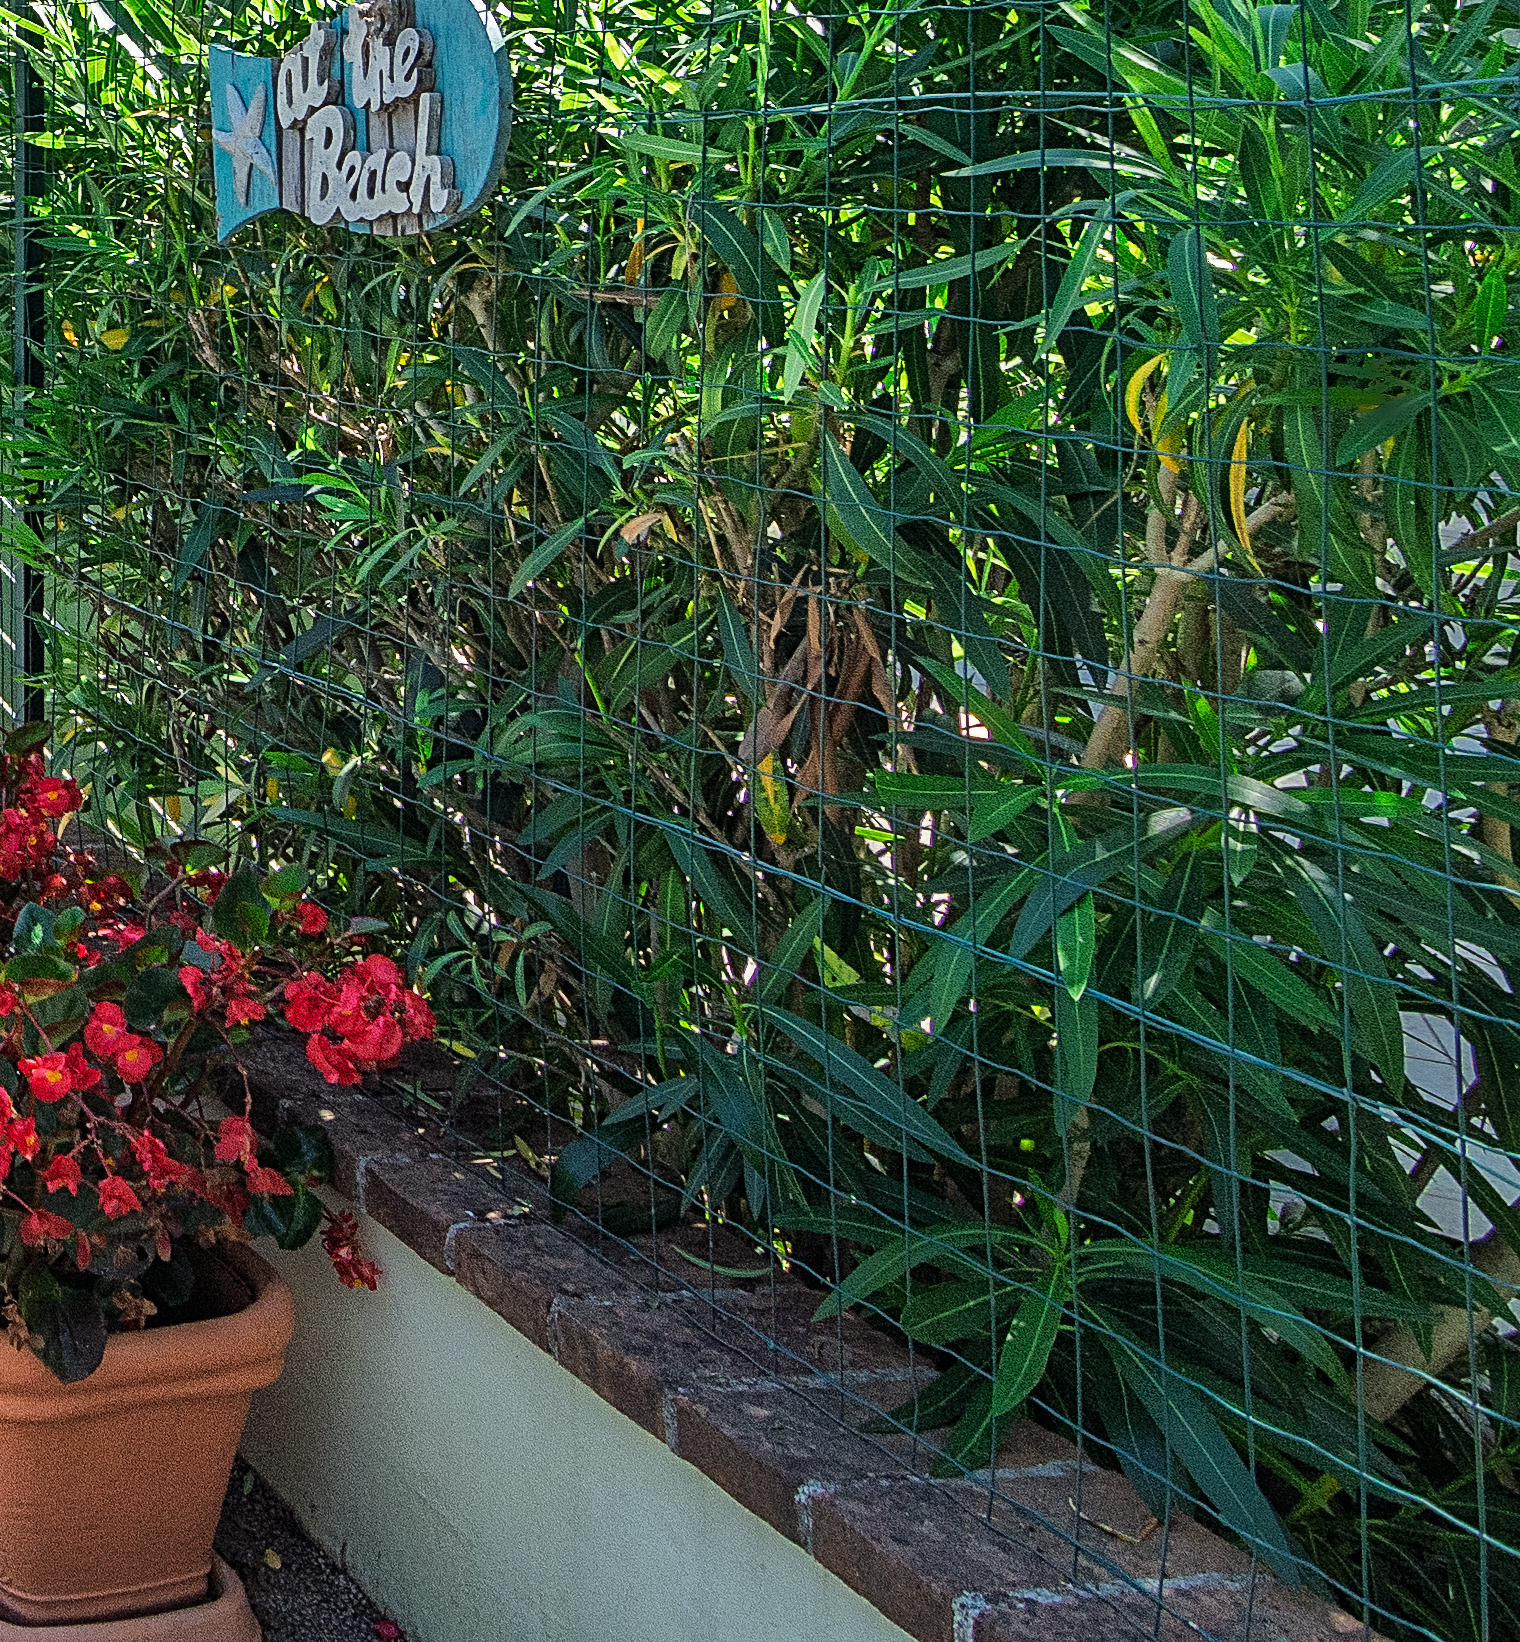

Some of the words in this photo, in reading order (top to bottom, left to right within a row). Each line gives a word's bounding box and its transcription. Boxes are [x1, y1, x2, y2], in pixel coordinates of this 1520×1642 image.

[277, 21, 337, 129] at
[344, 3, 433, 112] the
[306, 92, 453, 226] Beach
